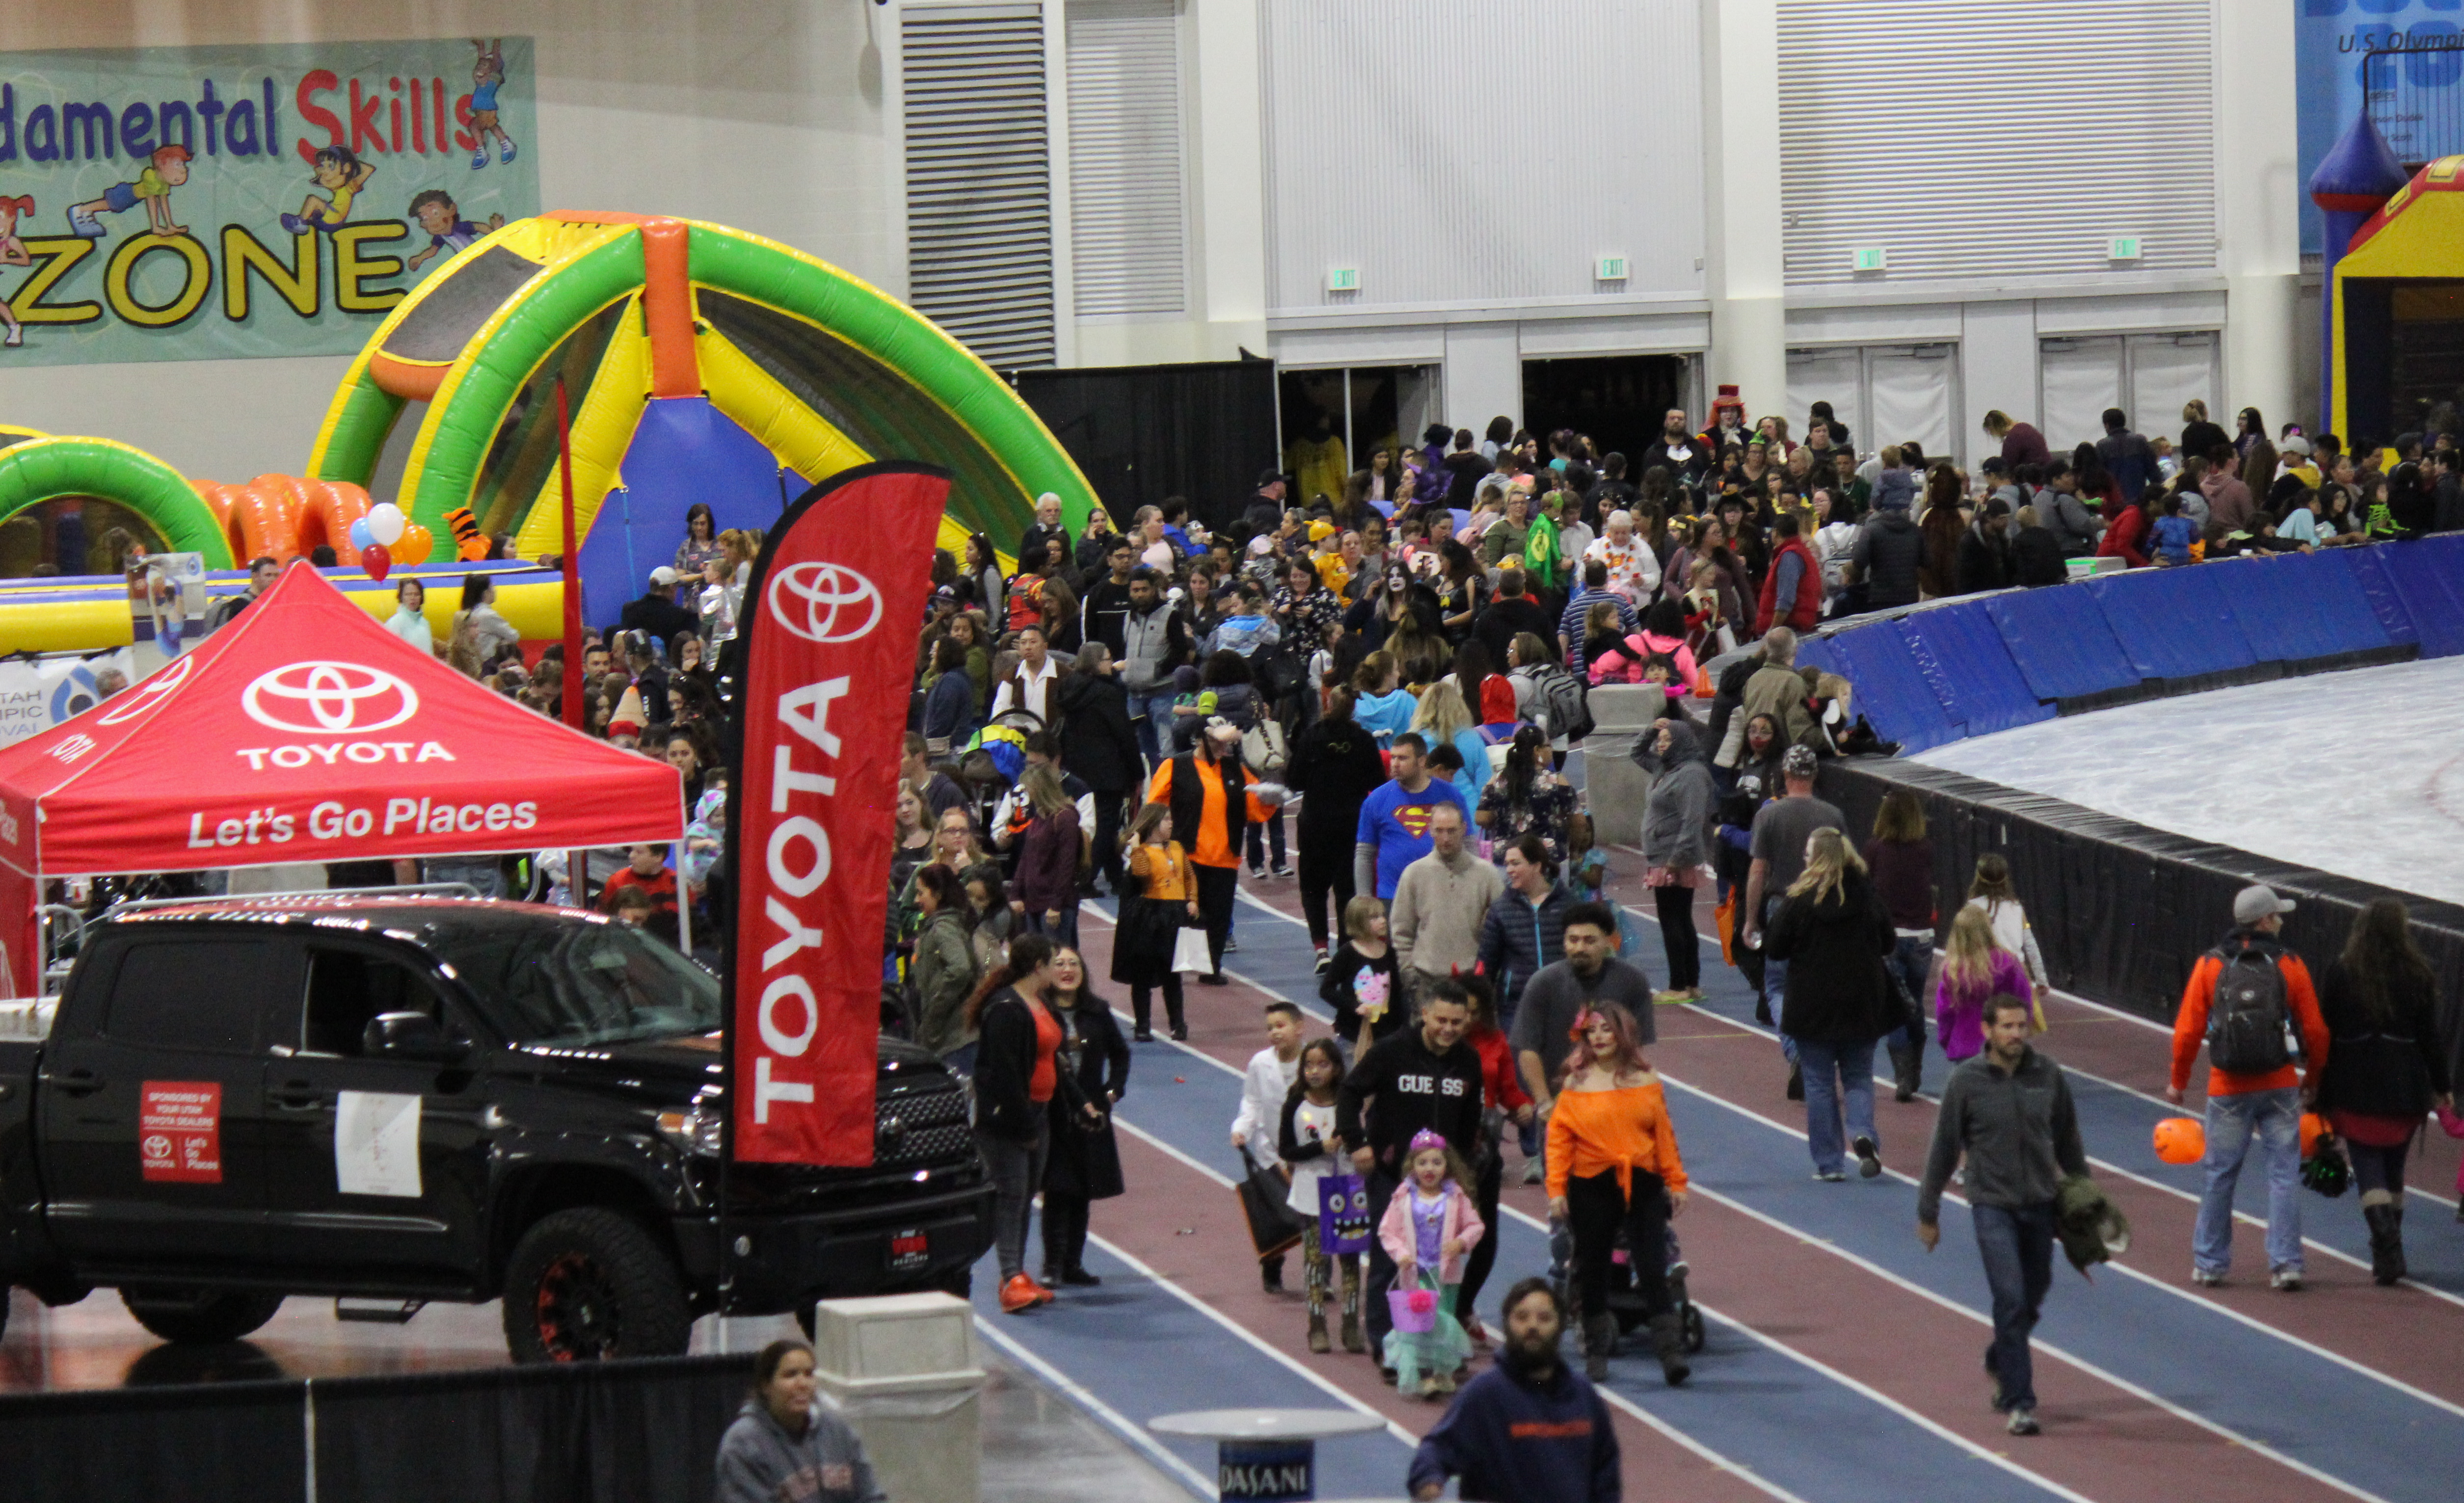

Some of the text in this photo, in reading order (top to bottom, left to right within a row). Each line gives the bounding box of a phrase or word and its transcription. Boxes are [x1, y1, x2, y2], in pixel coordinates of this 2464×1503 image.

[297, 69, 477, 166] Skills
[1859, 250, 1880, 268] EXIT
[2116, 240, 2136, 257] EXIT
[5, 219, 409, 328] ZONE
[1334, 270, 1355, 287] EXIT
[1603, 259, 1623, 276] EXIT
[0, 706, 43, 720] PIC
[236, 741, 456, 770] TOYOTA
[187, 797, 537, 848] Let's Go Places
[754, 675, 850, 1124] TOYOTA
[143, 1159, 175, 1168] TOYOTA
[1220, 1464, 1306, 1496] DASANI
